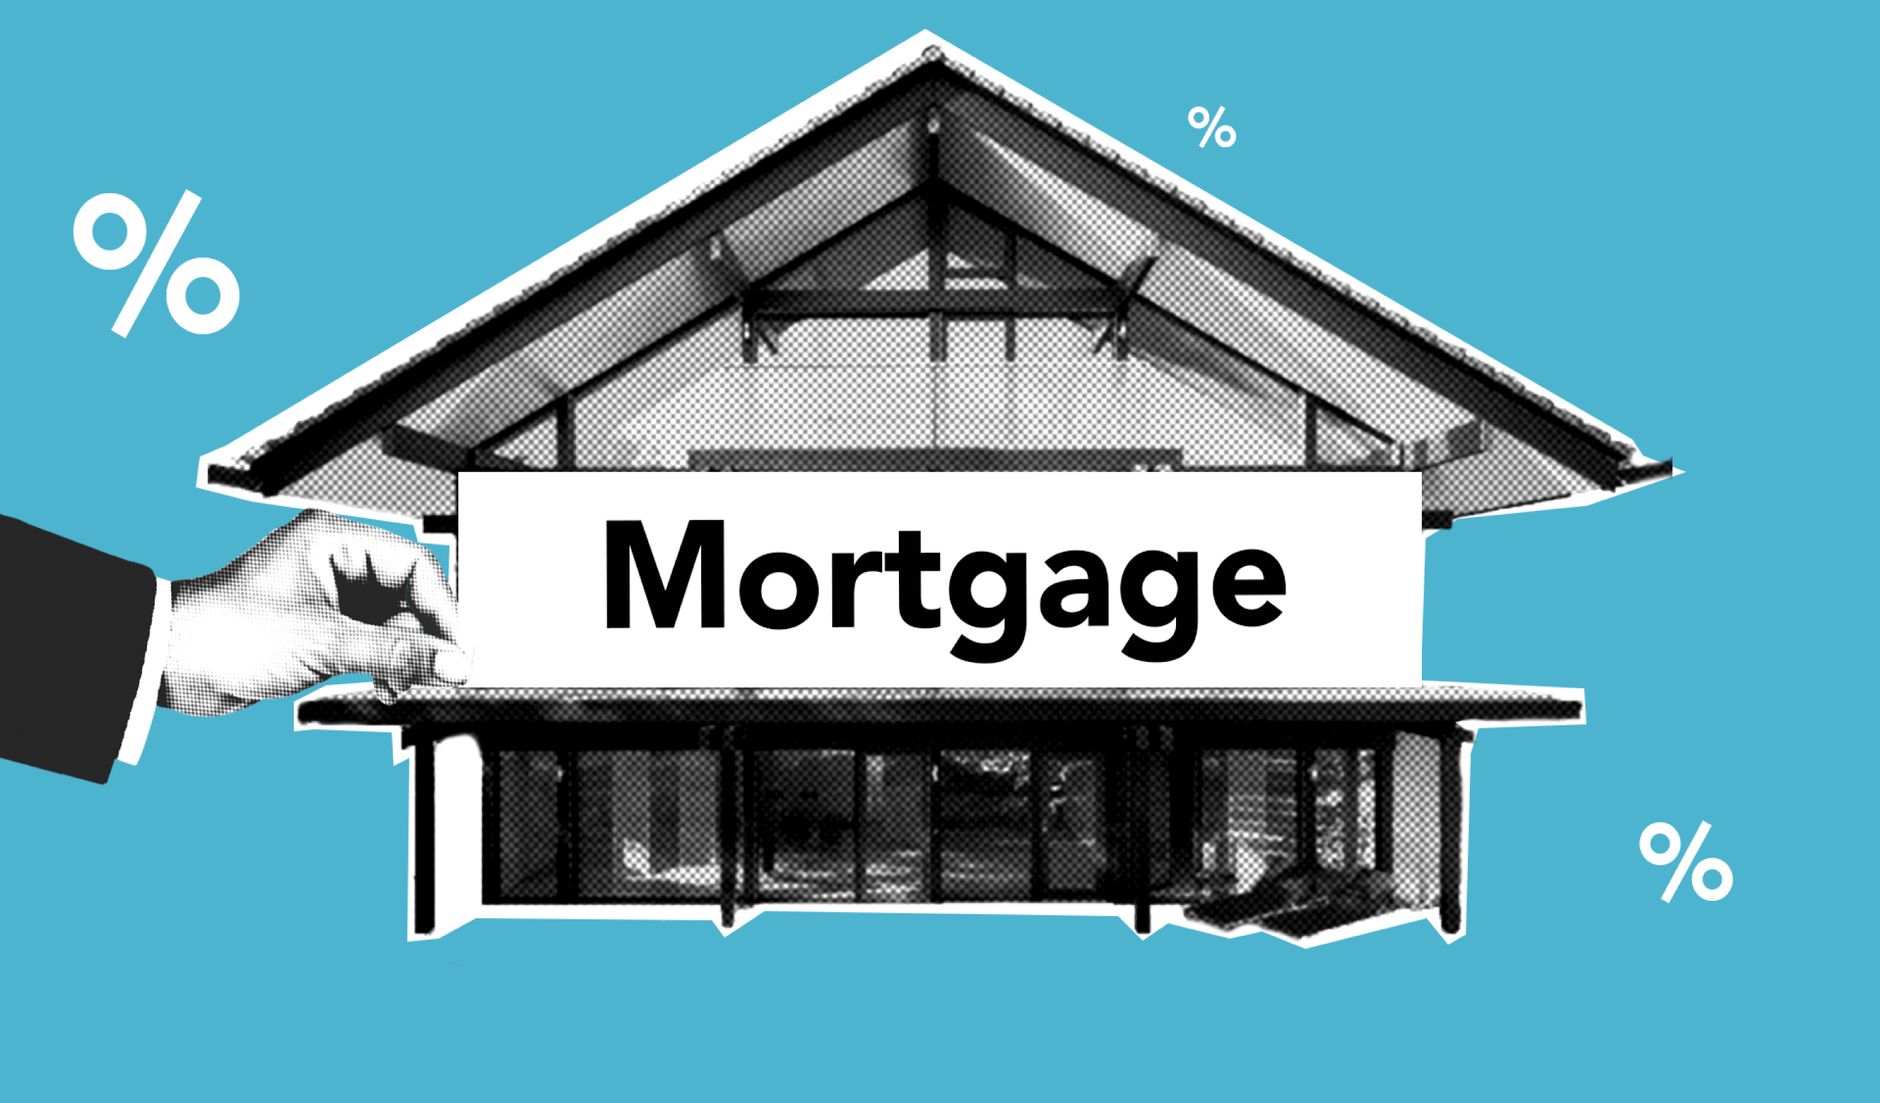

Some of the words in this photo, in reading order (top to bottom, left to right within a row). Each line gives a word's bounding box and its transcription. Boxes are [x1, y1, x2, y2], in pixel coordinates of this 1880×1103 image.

[1187, 106, 1237, 149] %
[73, 189, 240, 338] %
[605, 519, 1287, 664] Mortgage
[1638, 820, 1734, 903] %
